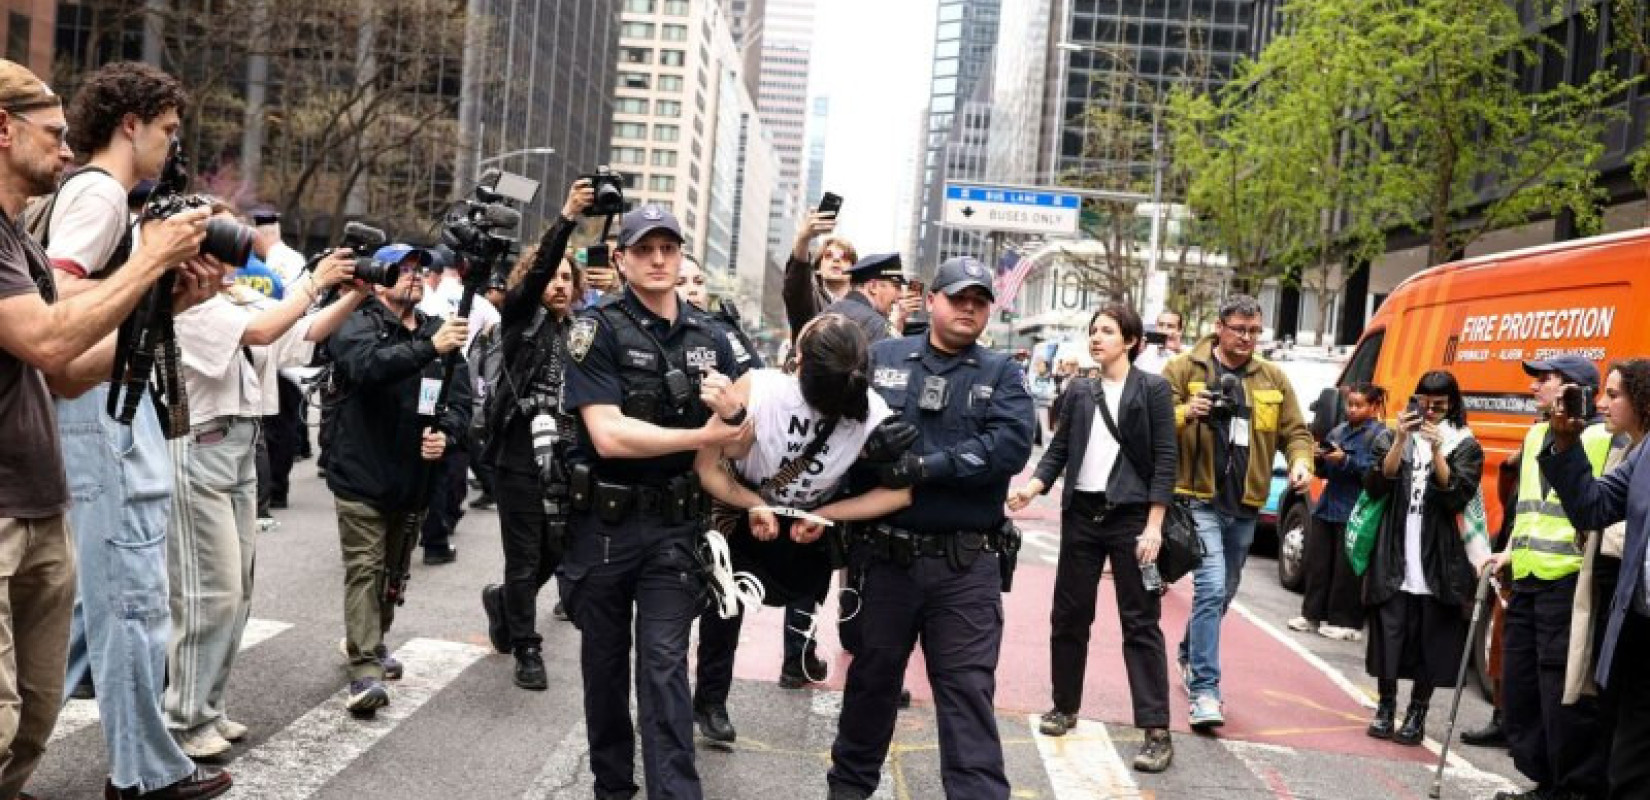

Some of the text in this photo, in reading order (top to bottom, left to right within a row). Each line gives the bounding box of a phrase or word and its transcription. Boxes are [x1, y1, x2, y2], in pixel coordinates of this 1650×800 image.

[990, 208, 1061, 225] BUSES ONLY
[1461, 306, 1615, 341] FIRE PROTECTION
[787, 441, 830, 455] WR
